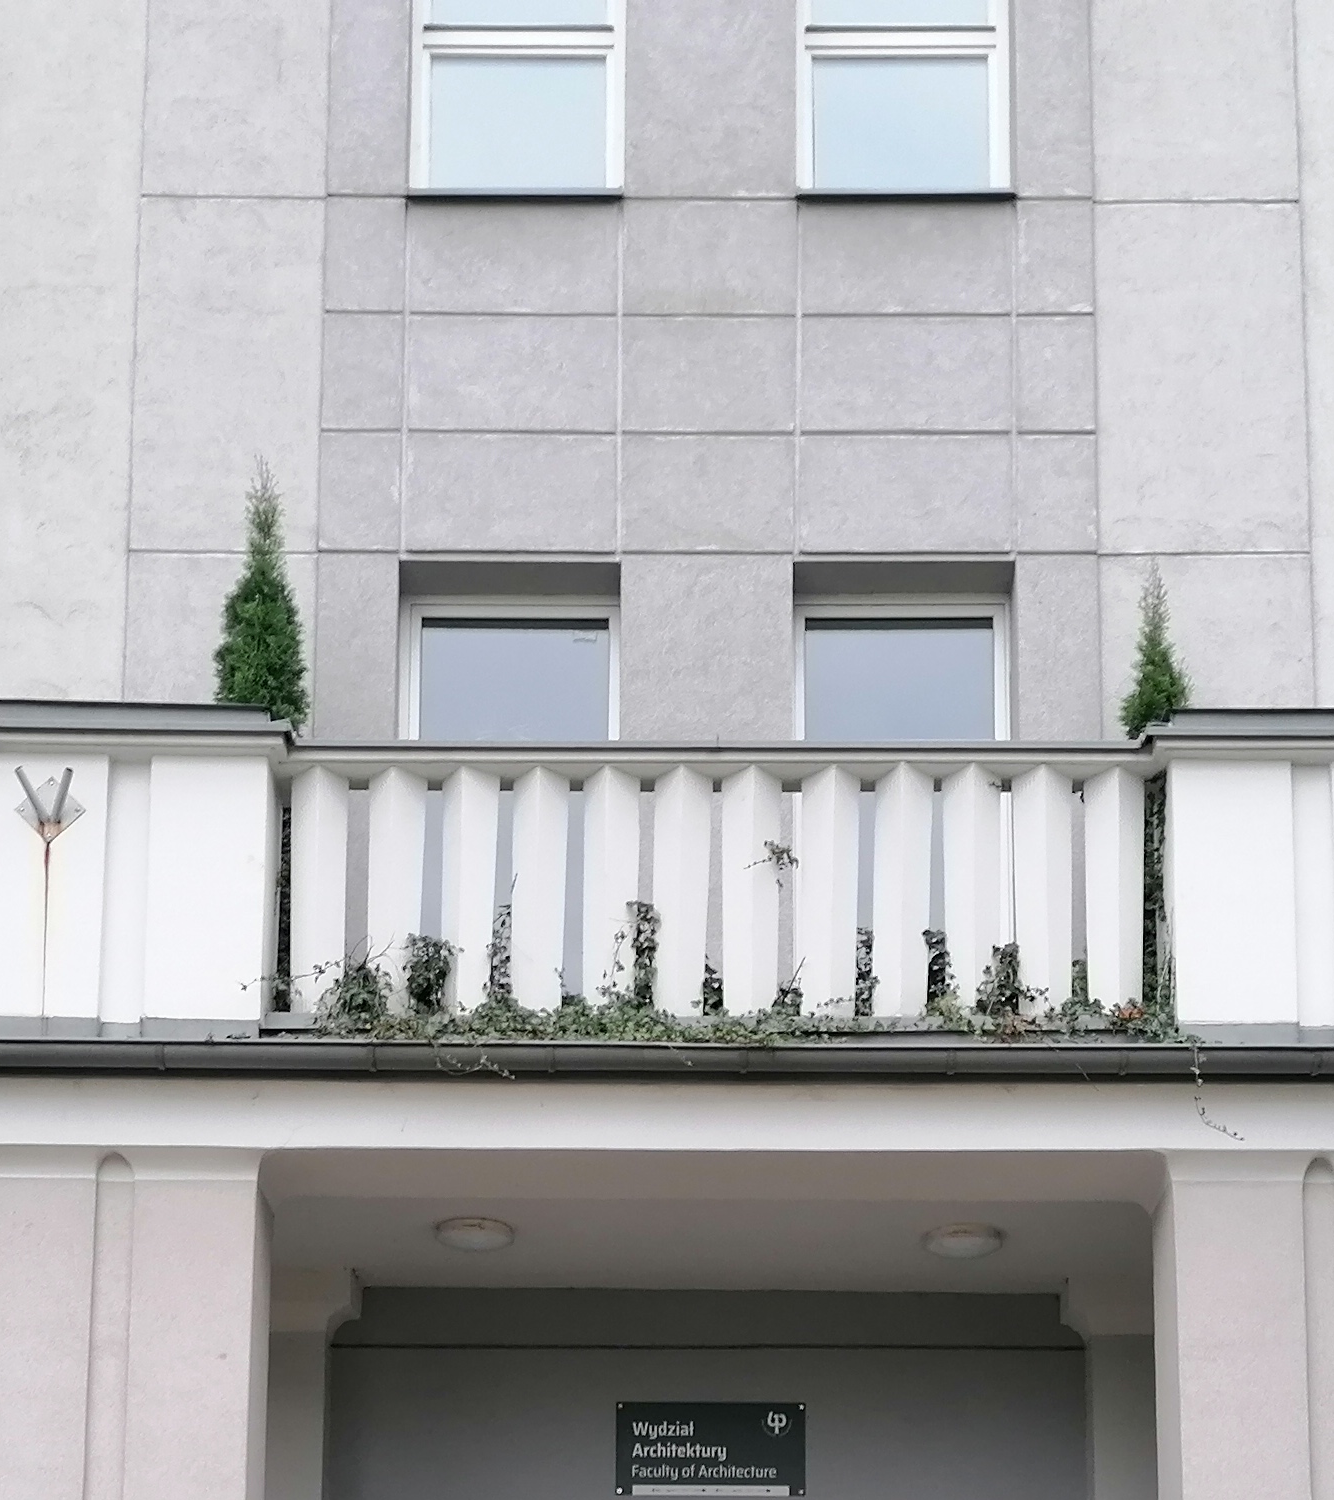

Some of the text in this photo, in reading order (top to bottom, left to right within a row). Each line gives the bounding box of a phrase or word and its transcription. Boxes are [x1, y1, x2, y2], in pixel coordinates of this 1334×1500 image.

[632, 1421, 694, 1440] Wydział
[632, 1442, 727, 1461] Architektury
[631, 1463, 777, 1481] Faculty of Architecture
